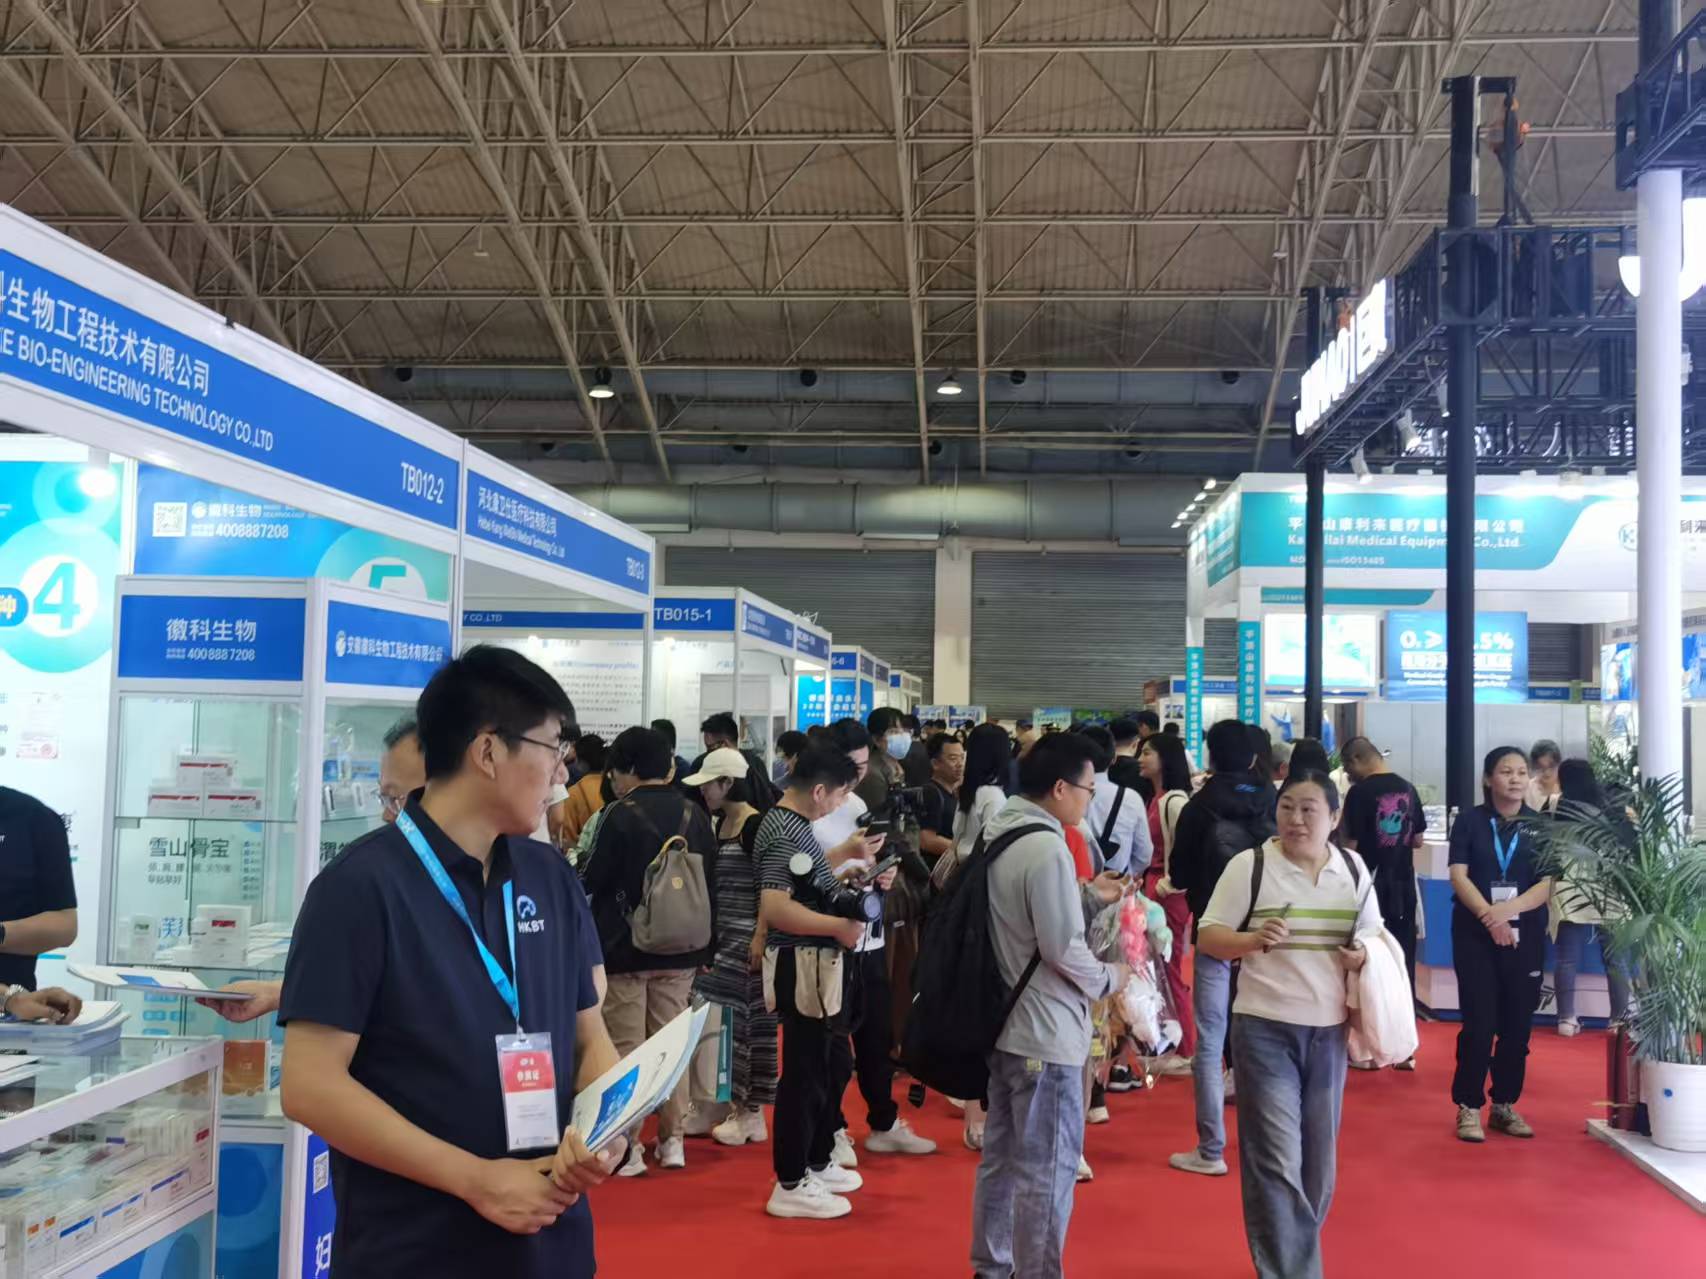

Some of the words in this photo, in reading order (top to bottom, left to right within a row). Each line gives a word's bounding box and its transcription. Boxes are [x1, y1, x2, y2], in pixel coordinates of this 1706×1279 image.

[18, 335, 150, 406] BIO-ENGINEERING
[154, 387, 234, 436] TECHNOLOGY
[234, 420, 273, 451] CO.,LTD
[401, 462, 444, 505] TB012-2
[215, 522, 290, 539] 4008887208
[1347, 534, 1398, 546] Medical
[33, 562, 80, 630] 4
[654, 607, 712, 621] TB015-1
[166, 618, 257, 643] 徽科生物
[517, 919, 545, 933] HKBT
